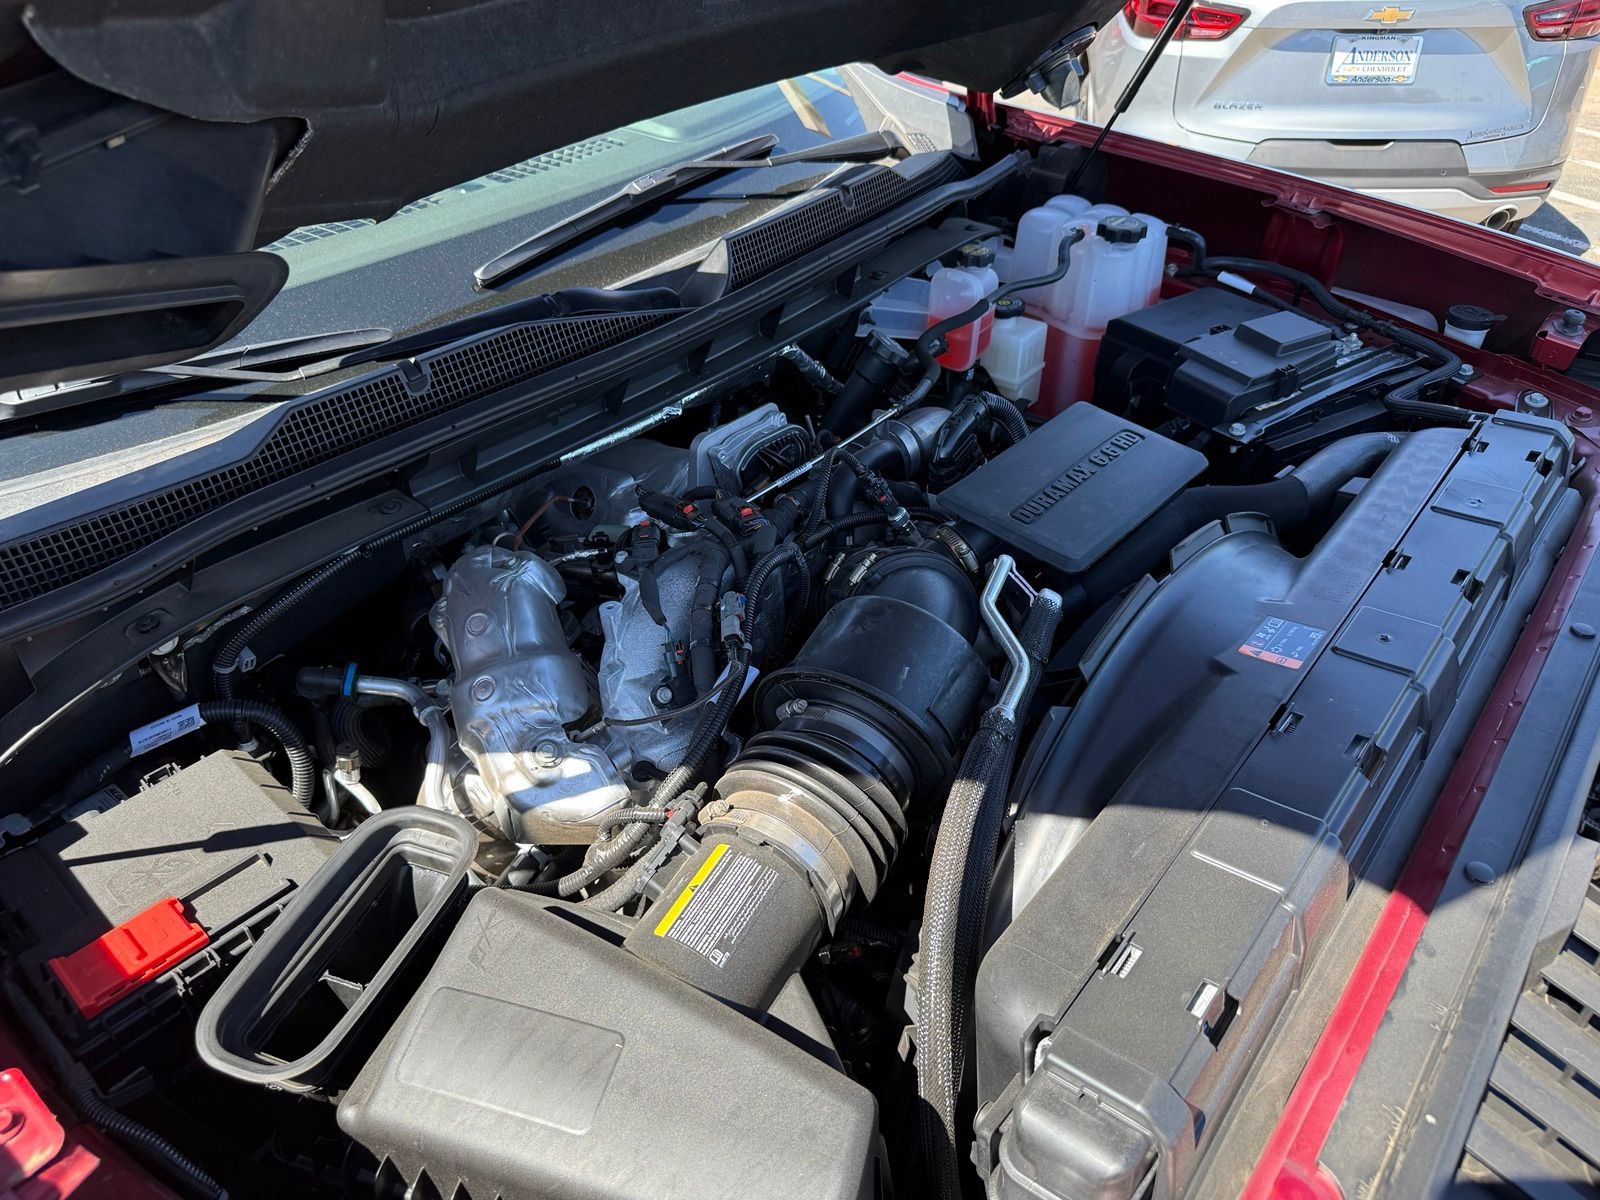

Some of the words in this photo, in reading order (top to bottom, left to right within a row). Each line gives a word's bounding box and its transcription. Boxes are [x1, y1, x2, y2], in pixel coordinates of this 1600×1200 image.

[1336, 47, 1412, 72] ANDERSON
[1350, 75, 1391, 83] Anderson
[1213, 102, 1263, 111] BLAZER
[1011, 464, 1097, 525] DURAMAX
[1089, 444, 1120, 468] 6.6
[1113, 430, 1142, 452] HD
